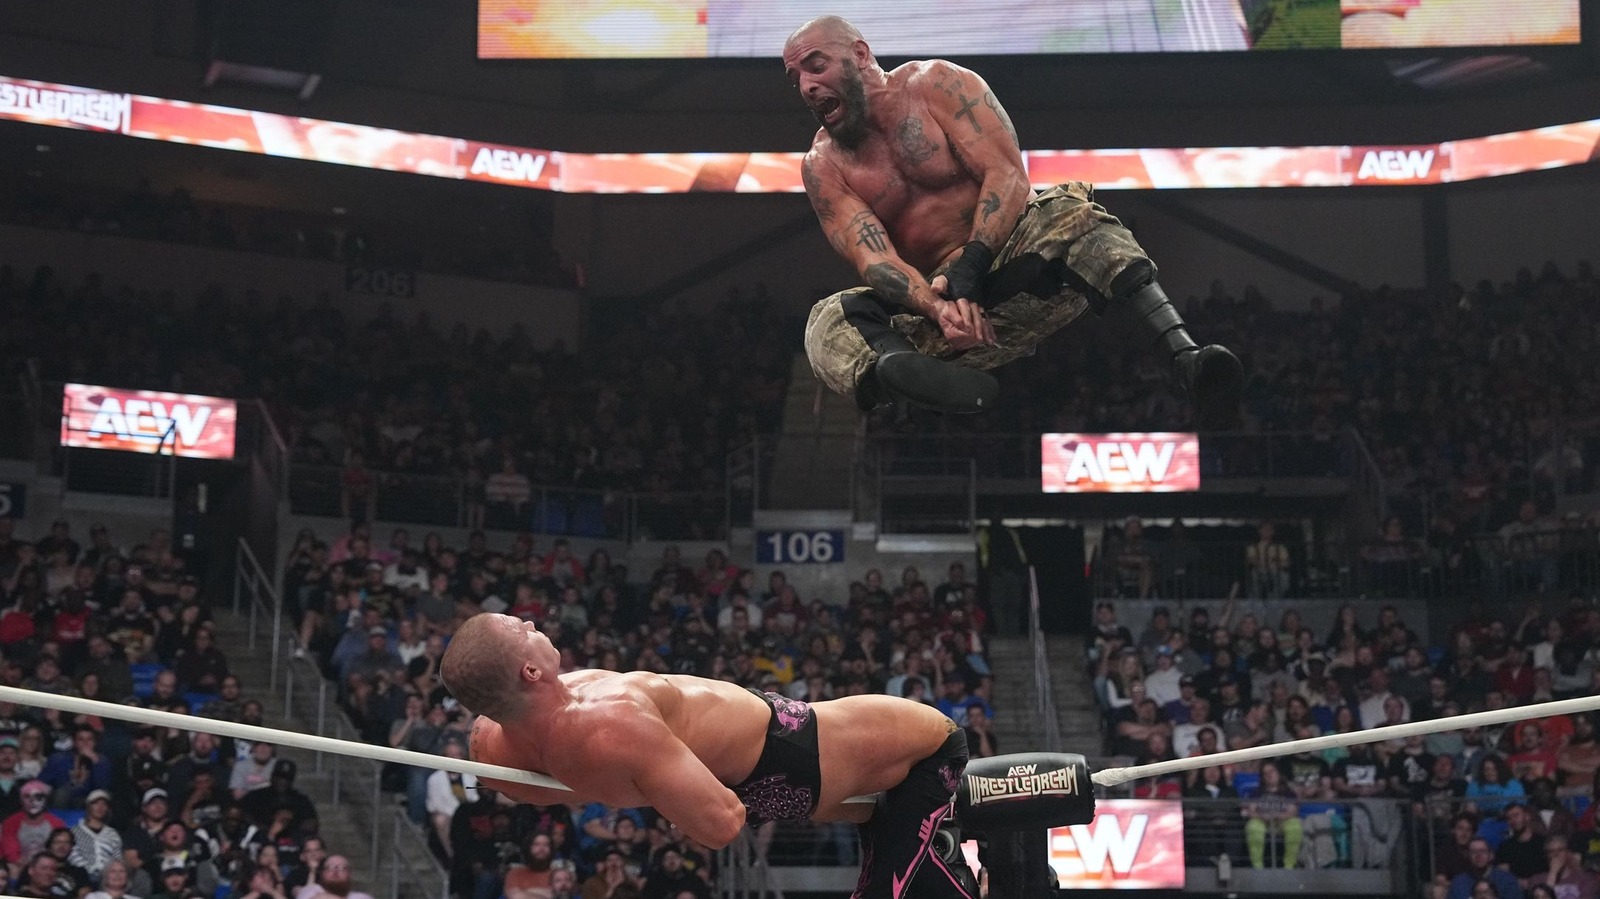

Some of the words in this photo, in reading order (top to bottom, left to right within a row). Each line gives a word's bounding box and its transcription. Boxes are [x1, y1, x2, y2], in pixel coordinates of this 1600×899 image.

[470, 147, 546, 182] AEW
[1357, 149, 1434, 179] AEW
[88, 397, 211, 446] AEW
[1064, 442, 1175, 482] AEW
[768, 532, 833, 562] 106
[967, 764, 1078, 806] WRESTLEDREAM
[1007, 764, 1037, 777] AEW
[1048, 814, 1149, 873] EW
